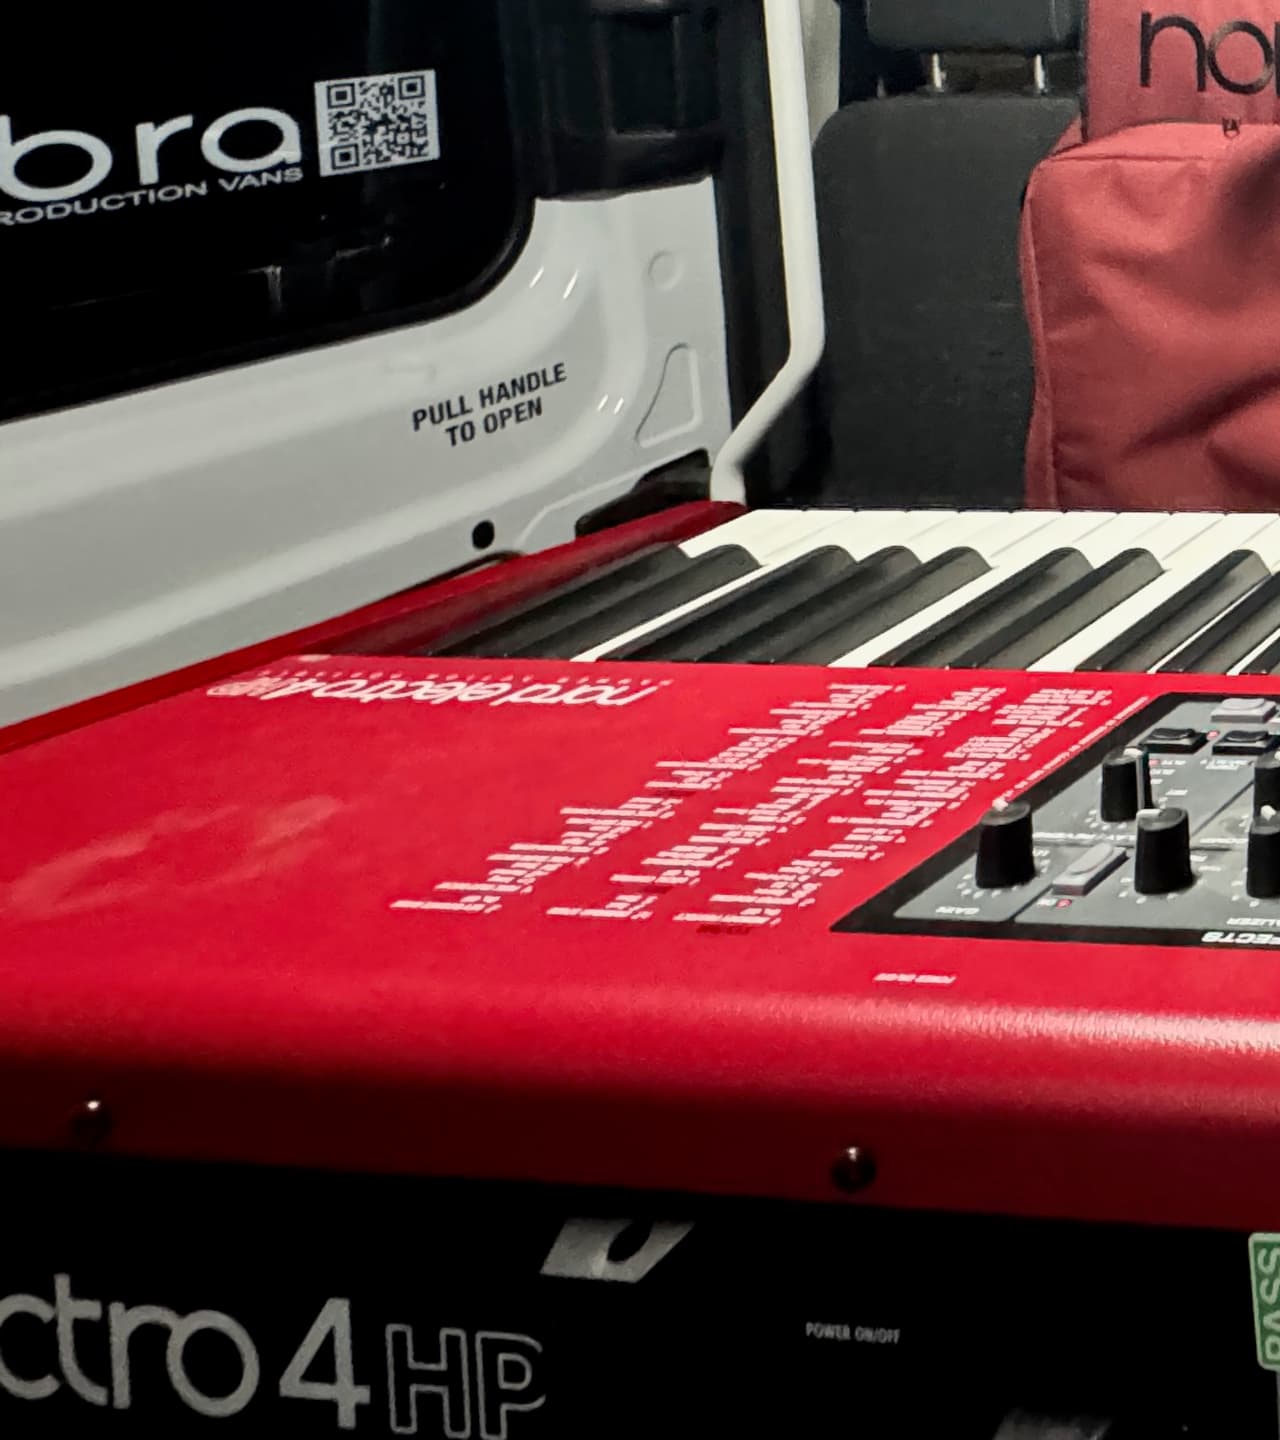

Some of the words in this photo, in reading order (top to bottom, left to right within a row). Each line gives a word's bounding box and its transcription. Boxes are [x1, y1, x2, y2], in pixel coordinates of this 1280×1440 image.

[0, 106, 302, 202] bra
[218, 167, 304, 192] VANS
[412, 395, 474, 432] PULL
[478, 362, 568, 409] HANDLE
[445, 421, 476, 447] TO
[483, 396, 543, 434] OPEN
[488, 683, 658, 707] nord
[935, 905, 980, 915] GAIN
[805, 1321, 851, 1340] POWER
